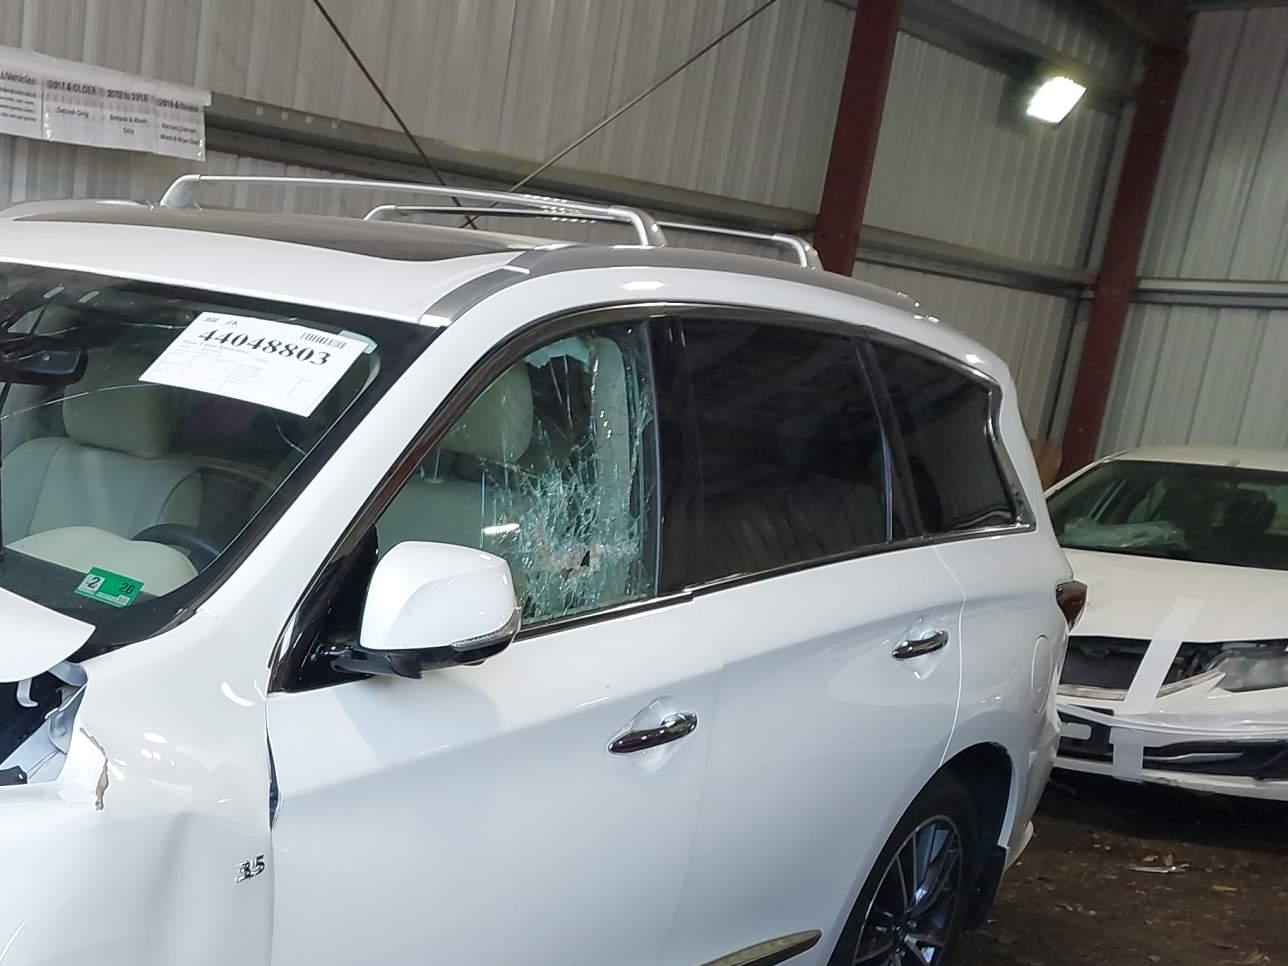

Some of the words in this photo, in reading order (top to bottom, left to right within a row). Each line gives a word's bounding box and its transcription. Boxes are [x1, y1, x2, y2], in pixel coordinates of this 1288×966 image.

[73, 83, 97, 96] OLDER
[198, 329, 332, 367] 44048803
[87, 576, 101, 589] 2
